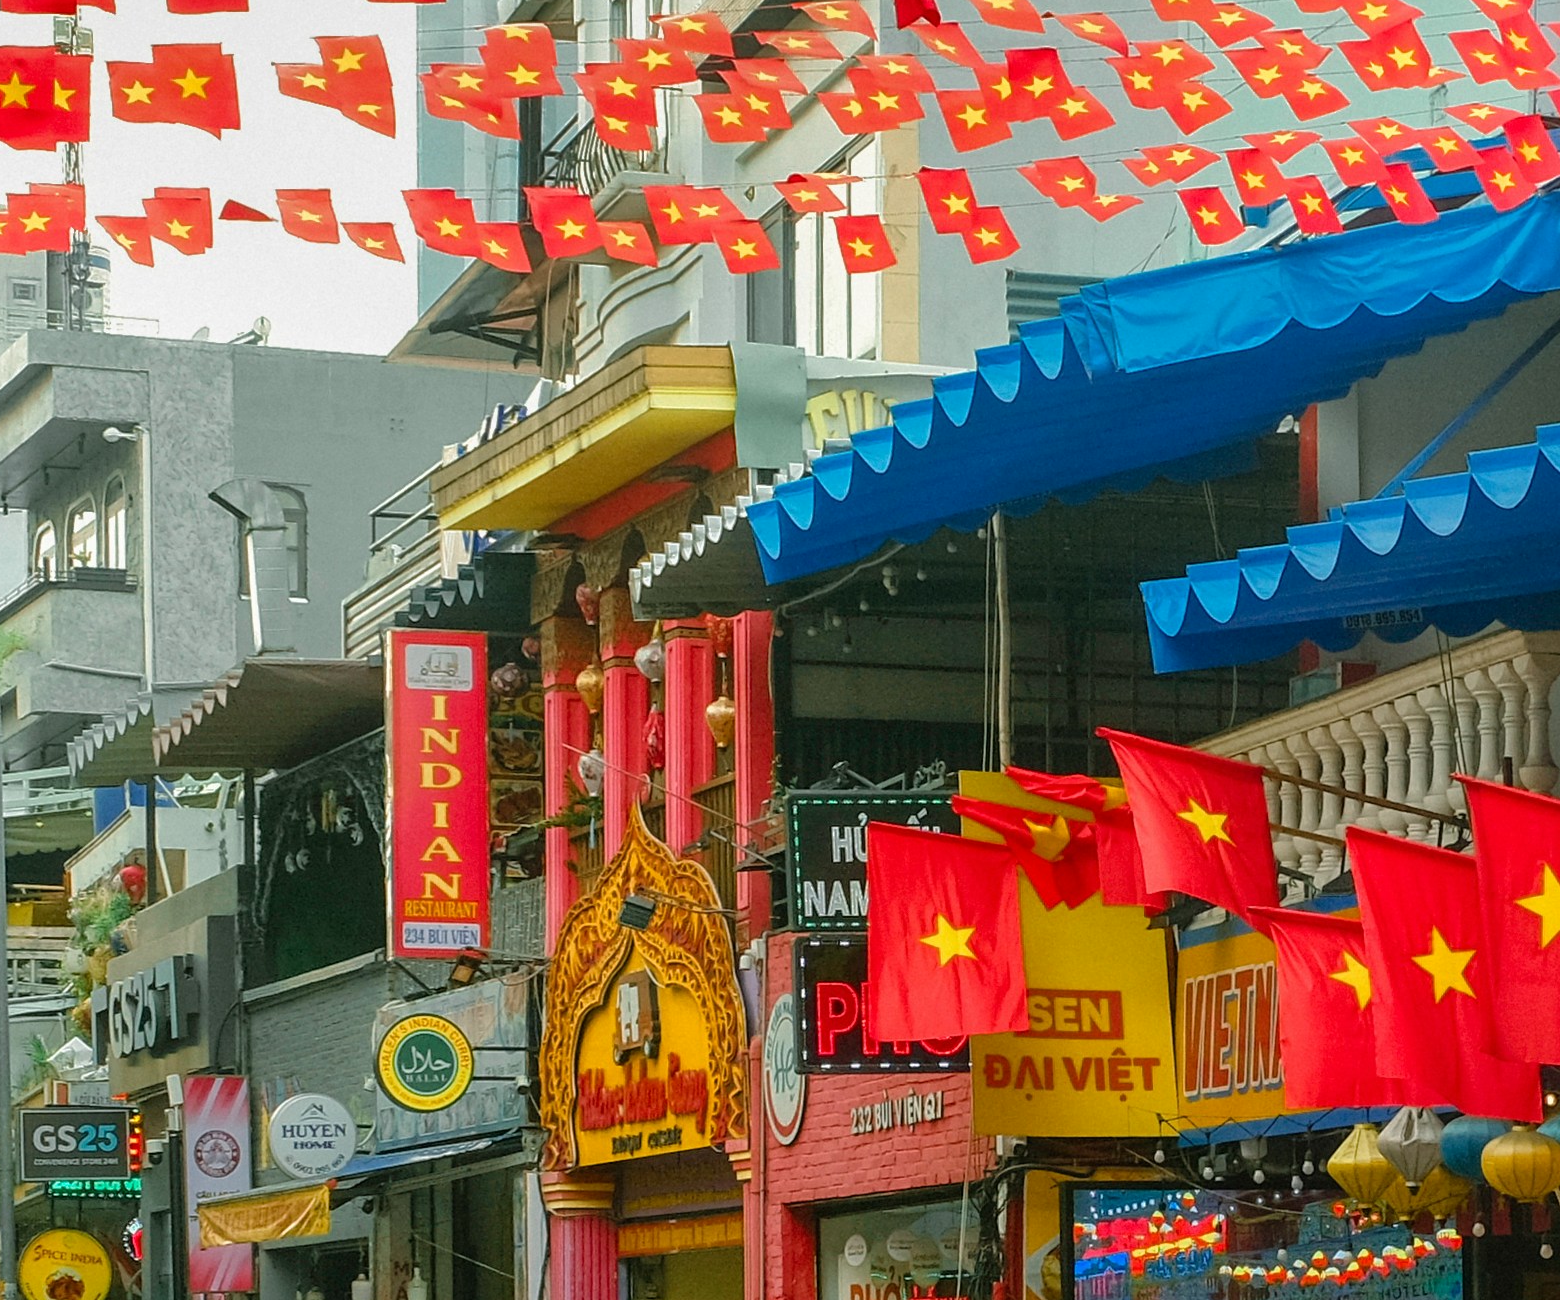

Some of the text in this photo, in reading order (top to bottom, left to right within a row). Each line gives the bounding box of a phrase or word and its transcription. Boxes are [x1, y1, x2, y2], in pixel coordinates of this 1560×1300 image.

[419, 694, 463, 900] INDIAN
[404, 899, 479, 919] RESTAURANT
[803, 881, 870, 917] NAM
[404, 926, 425, 946] 234
[108, 964, 158, 1060] GS25
[1028, 995, 1111, 1032] SEN
[409, 1017, 449, 1033] INDIAN
[449, 1030, 470, 1070] CURRY
[406, 1074, 447, 1082] HALAL
[984, 1047, 1161, 1102] ĐẠI VIỆT
[850, 1109, 873, 1135] 232
[875, 1089, 892, 1130] BÙI
[33, 1124, 118, 1153] GS25
[281, 1122, 347, 1140] HUYEN
[293, 1139, 337, 1151] HOME
[33, 1244, 104, 1267] SPICE INDIA
